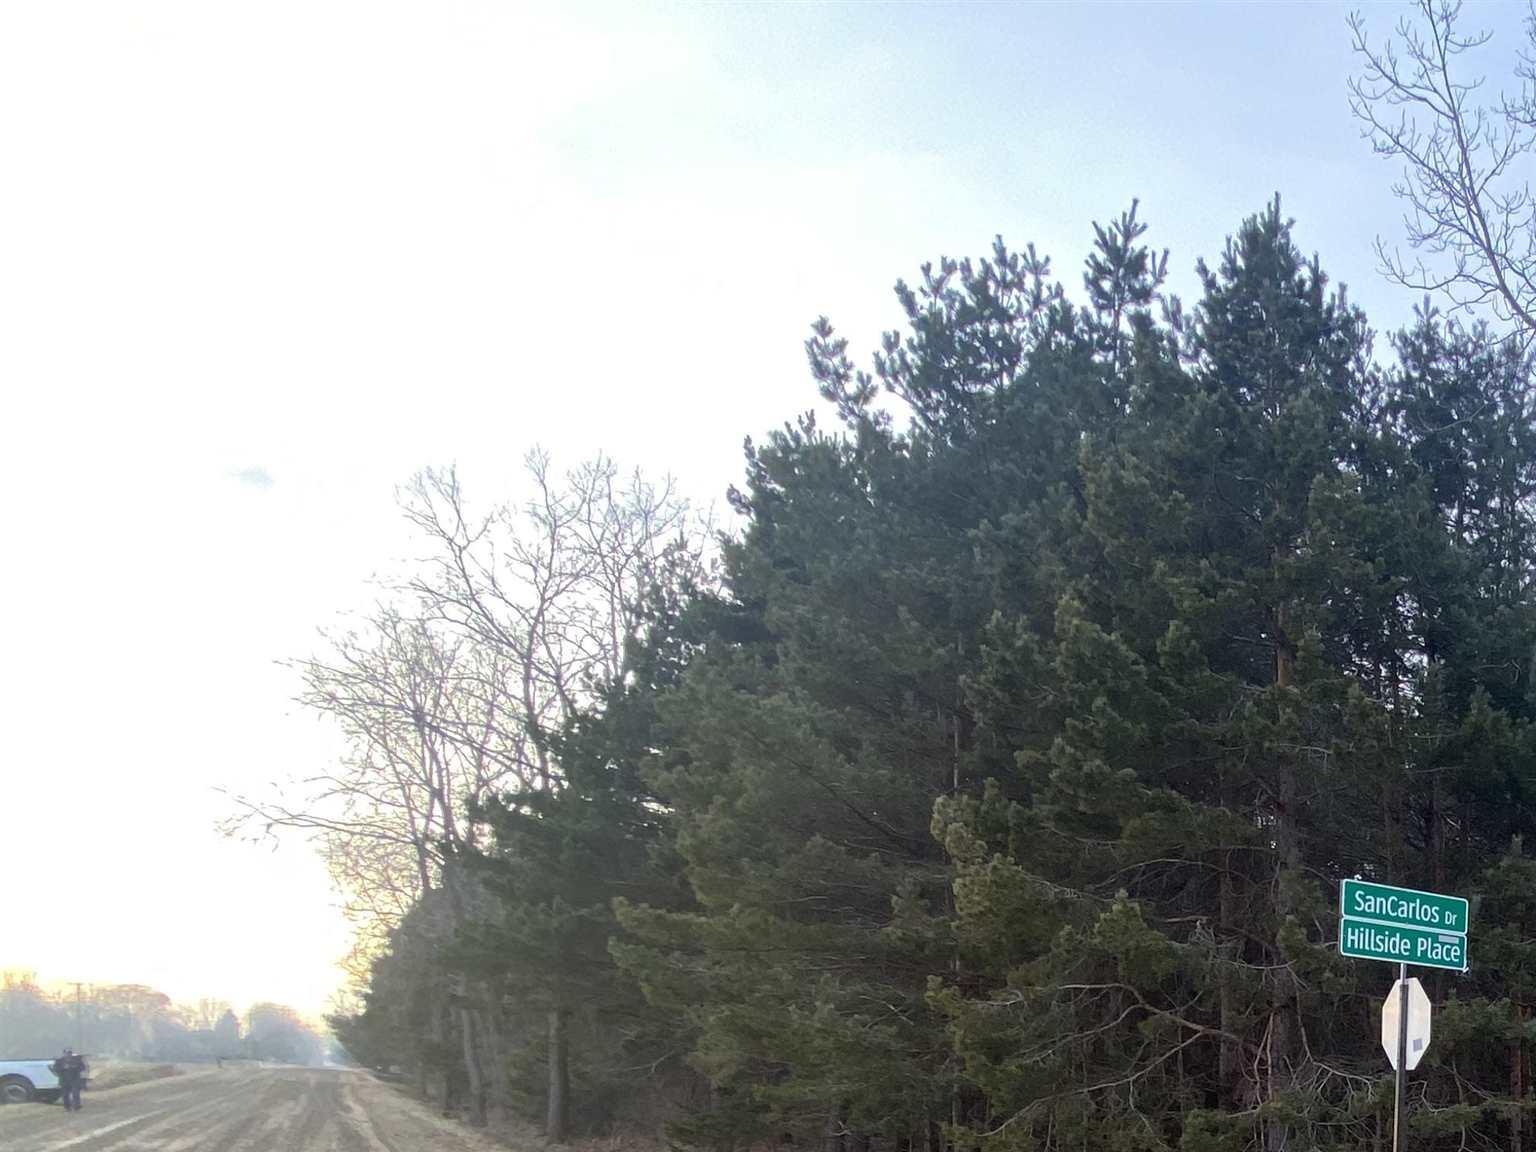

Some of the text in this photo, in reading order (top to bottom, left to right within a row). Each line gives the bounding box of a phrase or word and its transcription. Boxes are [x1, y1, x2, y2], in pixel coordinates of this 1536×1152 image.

[1354, 890, 1457, 926] SanCarlos Dr
[1347, 927, 1461, 962] Hillside Place
